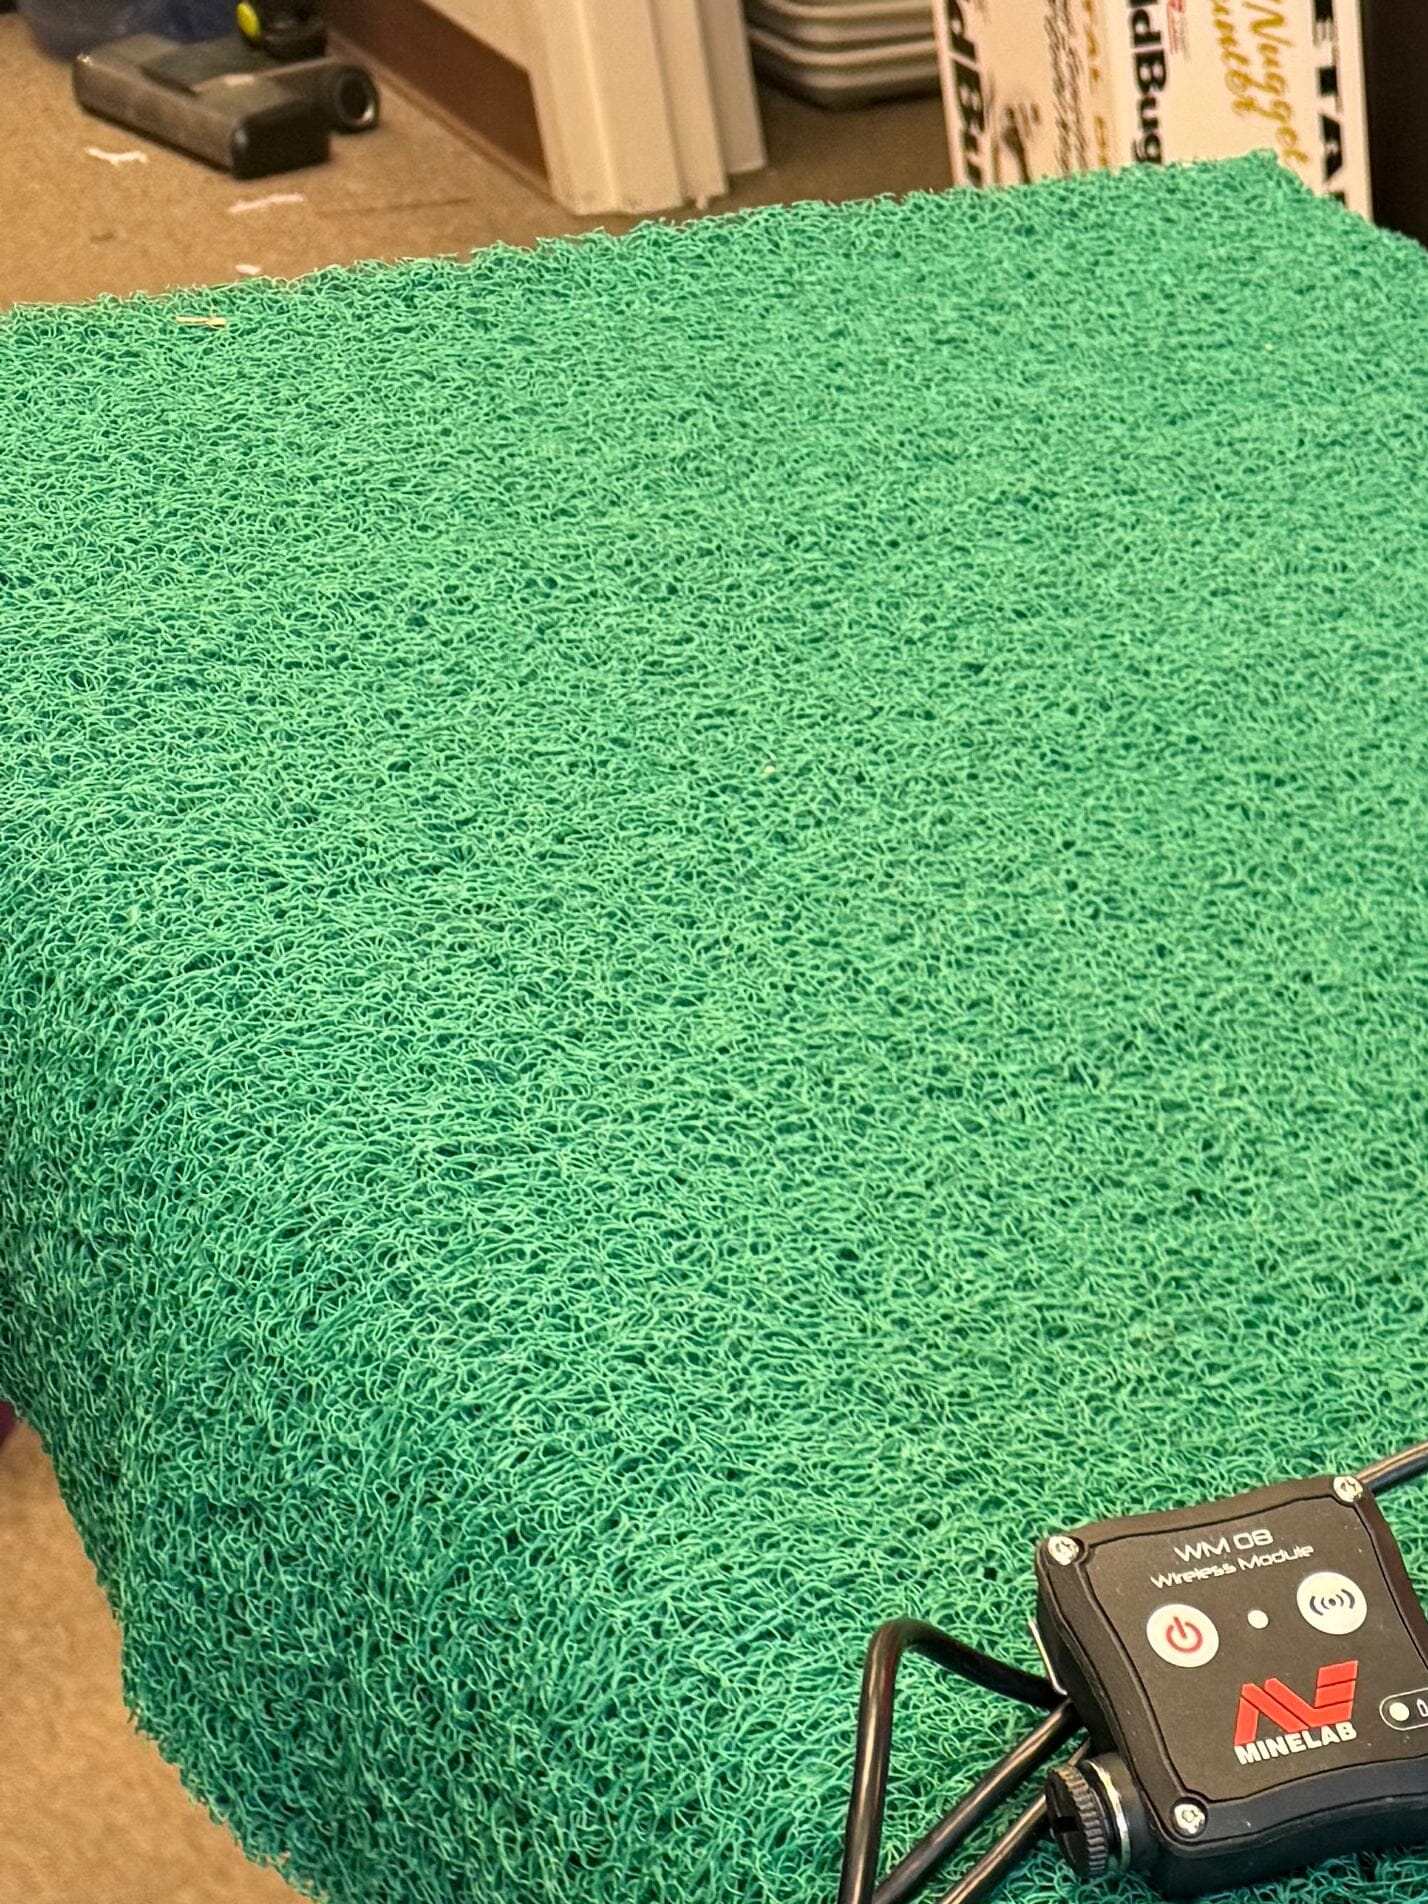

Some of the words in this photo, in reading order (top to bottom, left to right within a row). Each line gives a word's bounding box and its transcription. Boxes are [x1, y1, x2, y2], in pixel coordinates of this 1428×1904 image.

[1150, 1562, 1237, 1590] Wireless
[1237, 1544, 1315, 1572] Module
[1173, 1536, 1231, 1562] WM
[1233, 1528, 1274, 1550] 08
[1234, 1721, 1358, 1766] MINELAB
